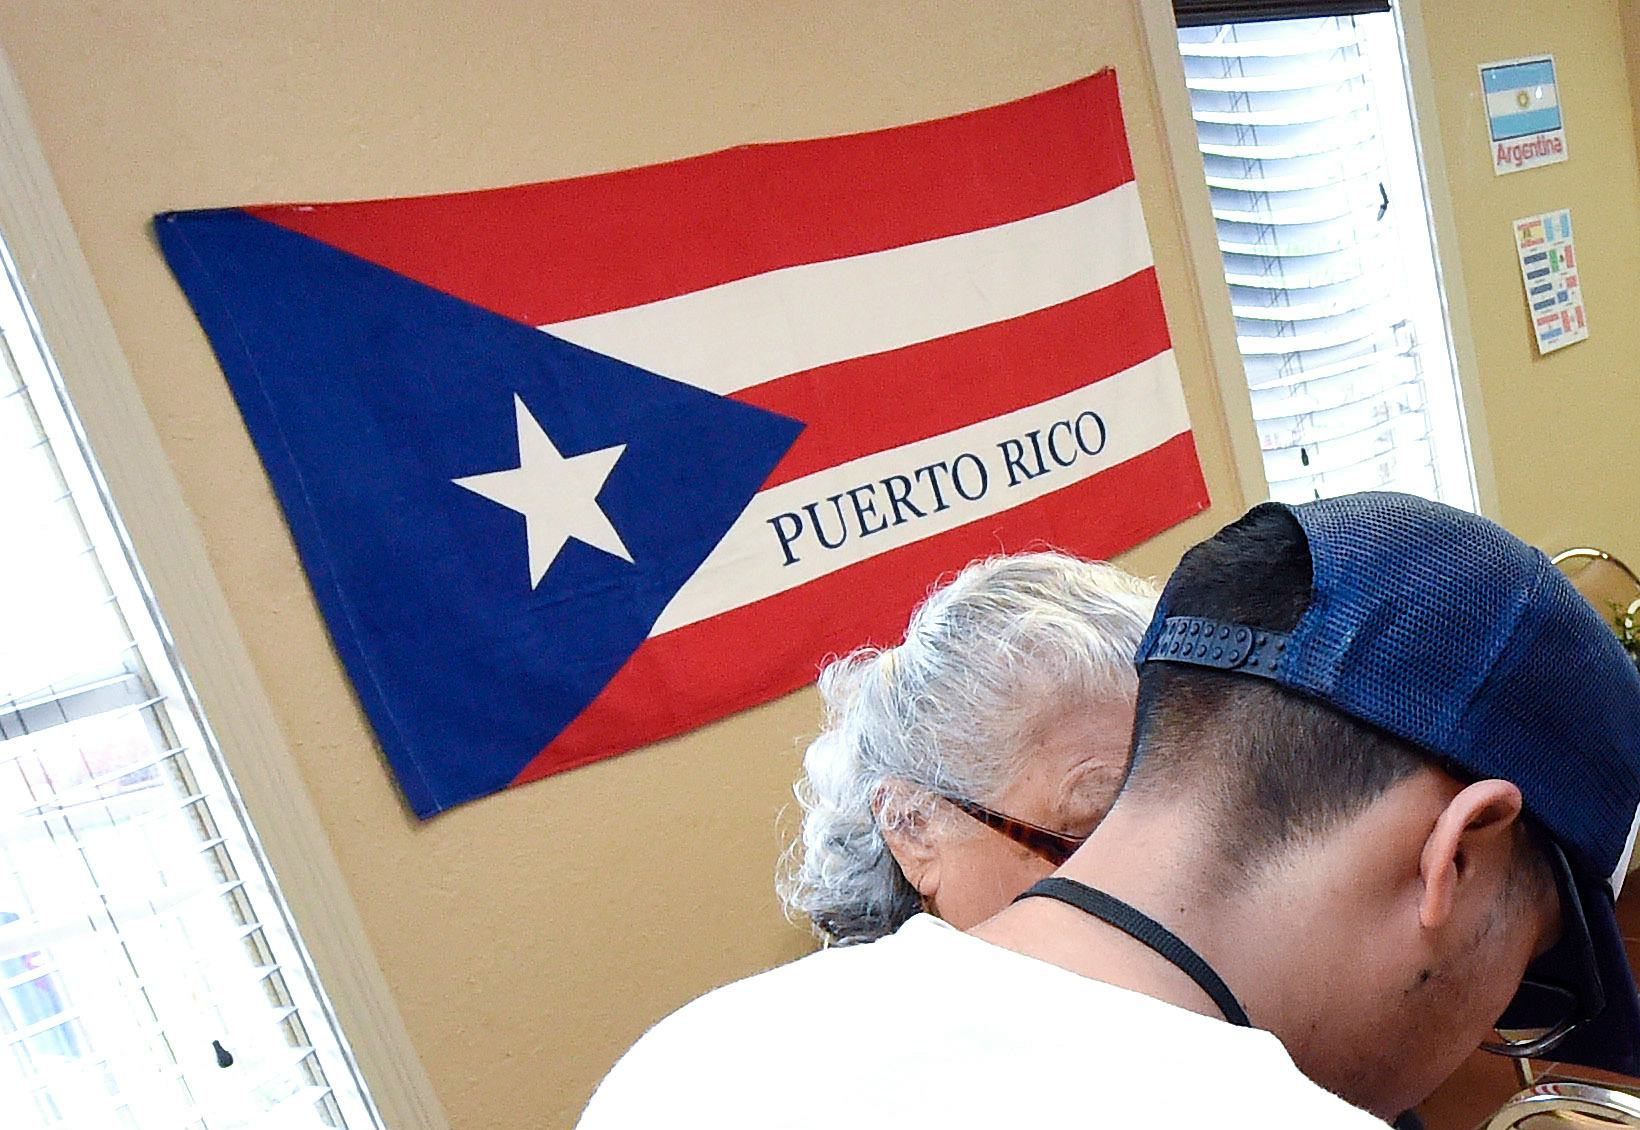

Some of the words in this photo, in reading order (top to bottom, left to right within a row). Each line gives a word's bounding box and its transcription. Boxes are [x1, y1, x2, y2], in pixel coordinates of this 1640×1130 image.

[1497, 135, 1563, 167] Argentina
[766, 453, 988, 567] PUERTO
[996, 411, 1107, 488] RICO
